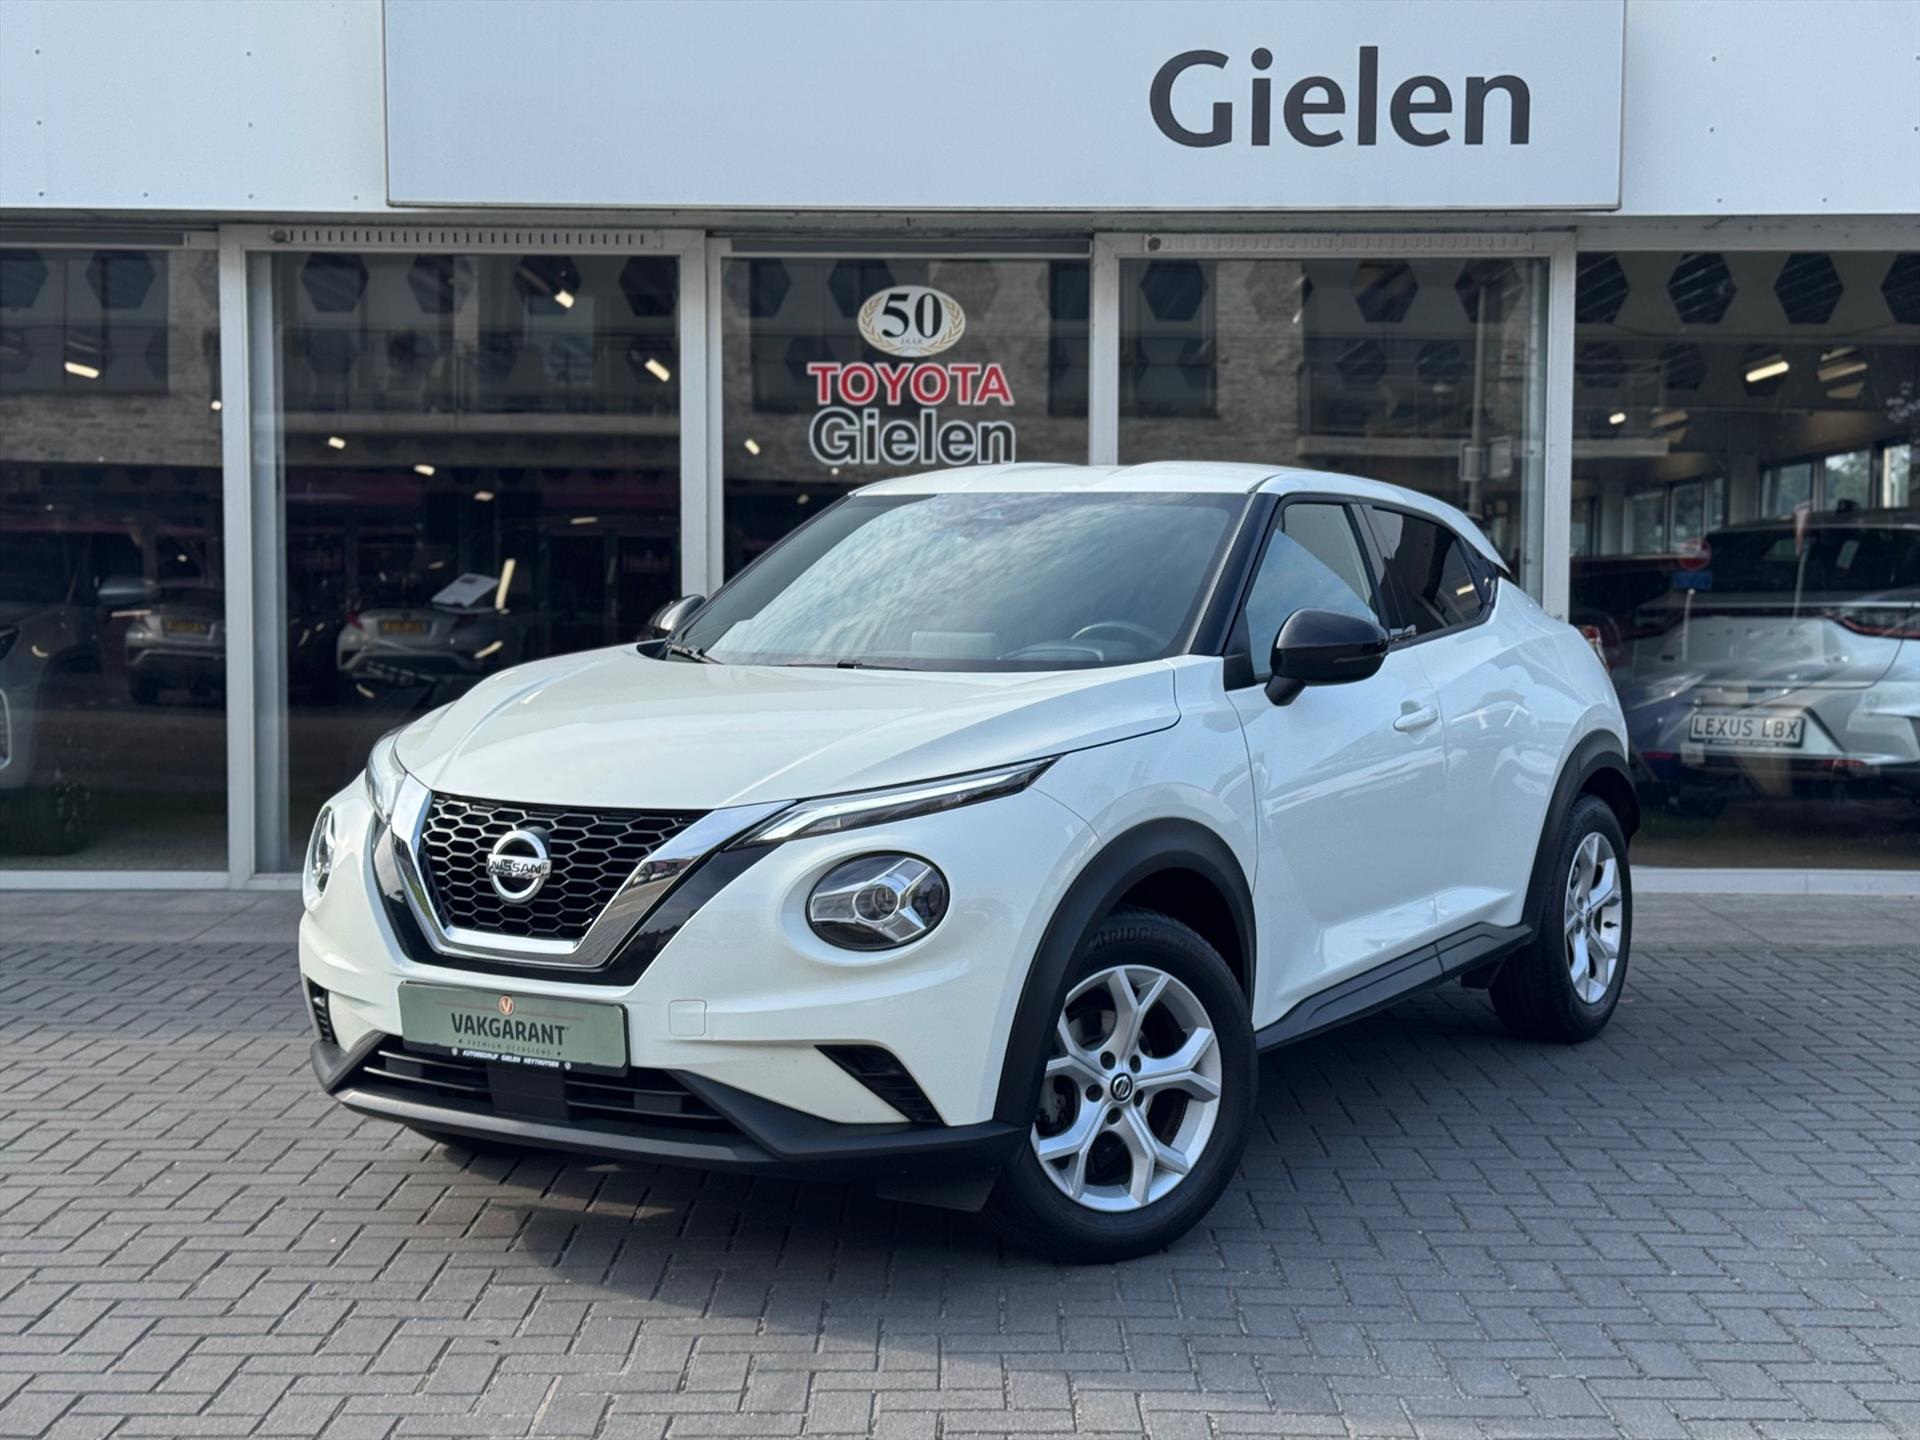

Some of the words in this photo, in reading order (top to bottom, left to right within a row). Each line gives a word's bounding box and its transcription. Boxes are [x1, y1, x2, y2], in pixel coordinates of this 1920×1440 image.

[1149, 45, 1531, 148] Gielen
[881, 292, 943, 339] 50
[807, 363, 1015, 405] TOYOTA
[809, 407, 1016, 465] Gielen
[1694, 717, 1753, 737] LEXUS
[1761, 718, 1799, 740] LBX
[490, 859, 542, 875] NISSAN
[451, 1013, 566, 1046] VAKGARANT
